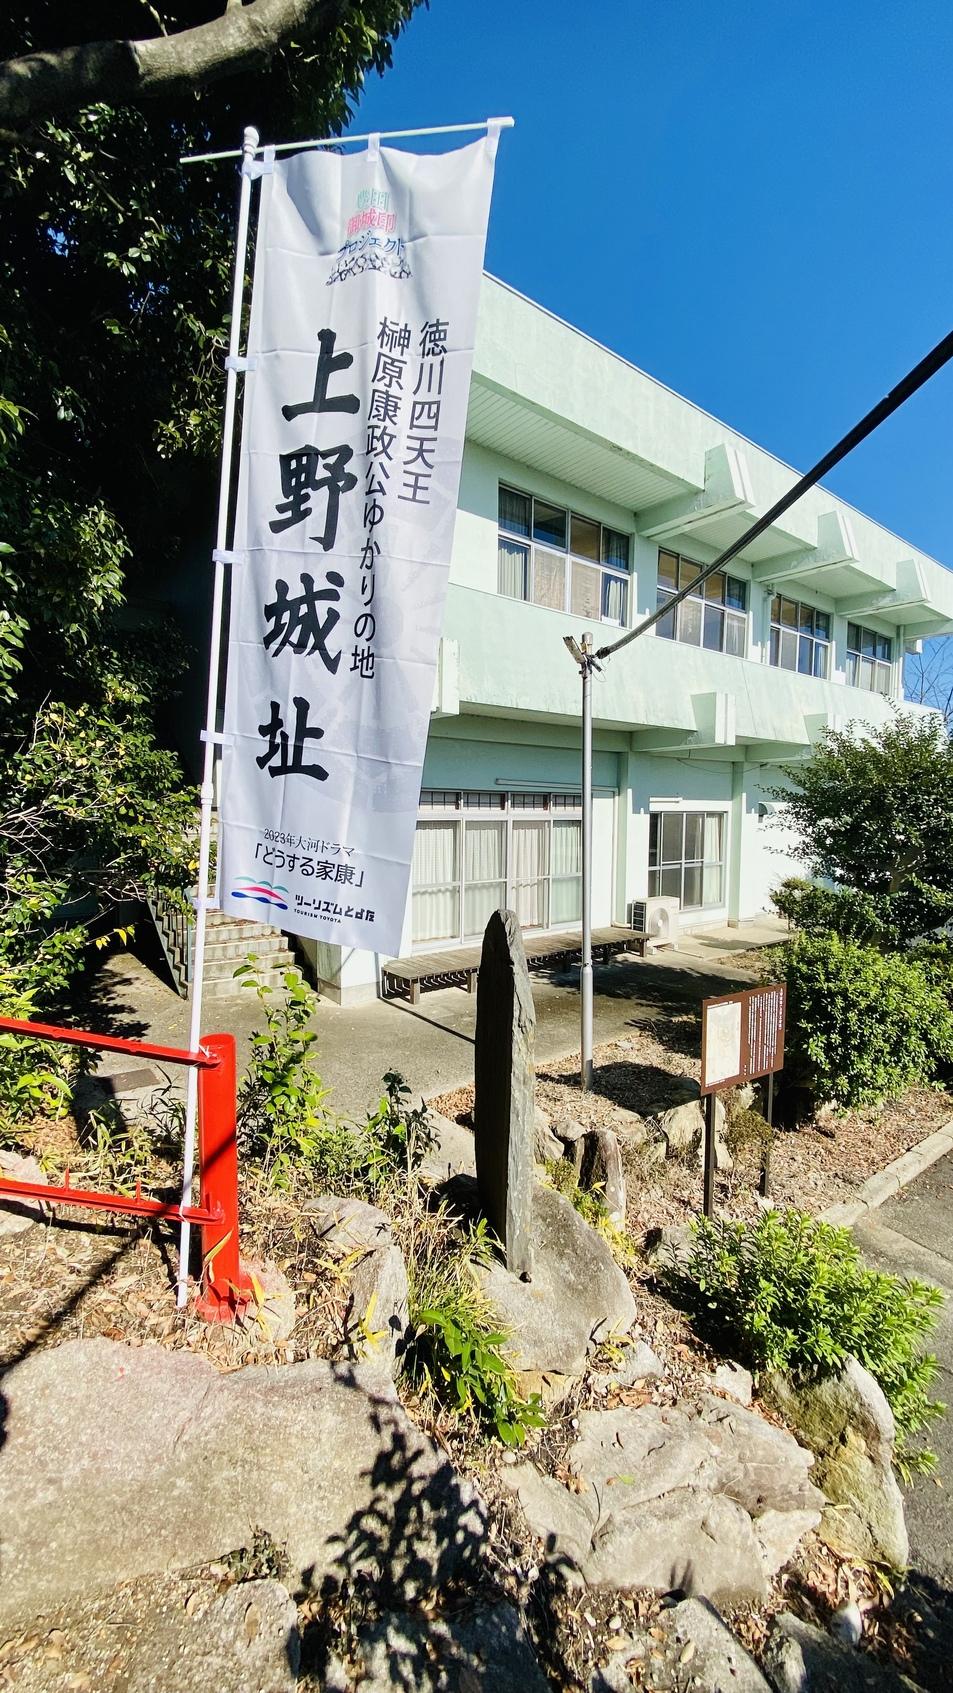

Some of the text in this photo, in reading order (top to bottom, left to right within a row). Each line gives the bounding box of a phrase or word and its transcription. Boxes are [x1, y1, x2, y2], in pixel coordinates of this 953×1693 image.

[336, 230, 405, 260] プロジェクト
[397, 318, 450, 505] 徳川四天王
[350, 317, 411, 679] 榊原康政公ゆかりの地
[256, 328, 360, 781] 上野城址
[264, 828, 355, 857] 2023年大河ドラマ
[255, 843, 365, 888] 「どうする家康」
[294, 908, 341, 924] TOURISM TOYOTA
[295, 894, 375, 922] ツーリズムとよた
